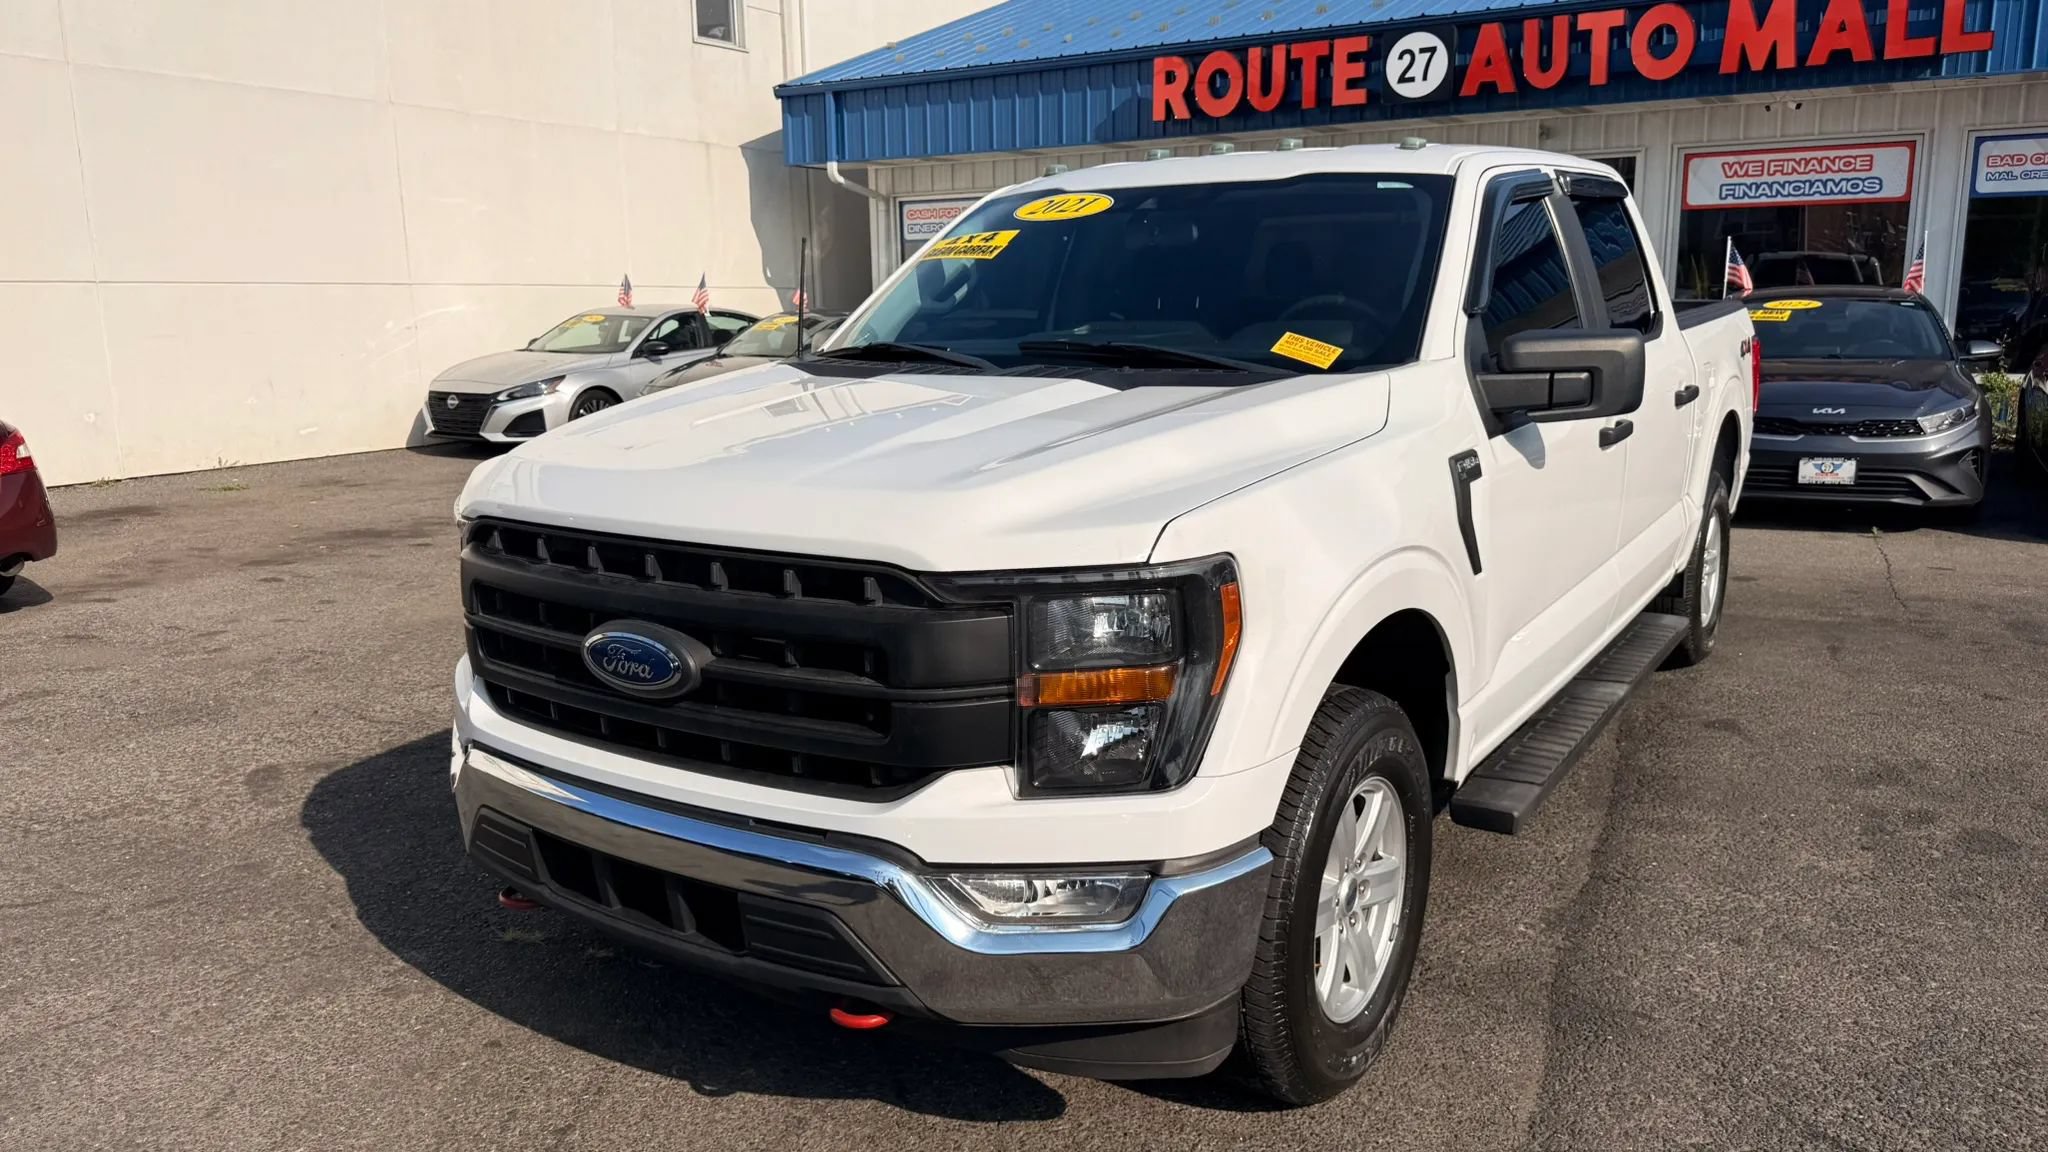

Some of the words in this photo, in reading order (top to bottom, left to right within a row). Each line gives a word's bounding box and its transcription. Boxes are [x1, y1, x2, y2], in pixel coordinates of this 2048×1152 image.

[1152, 36, 1368, 121] ROUTE
[1397, 46, 1437, 84] 27
[1459, 2, 1696, 97] AUTO
[1719, 0, 1994, 74] MALL
[1722, 159, 1764, 179] WE
[1768, 155, 1873, 177] FINANCE
[1987, 154, 2028, 168] BAD
[1986, 171, 2018, 182] MAL
[1719, 176, 1882, 200] FINANCIAMOS
[907, 208, 938, 220] CASH
[939, 207, 960, 218] FOR
[1026, 197, 1100, 215] 2021
[979, 232, 999, 242] 4
[954, 245, 1003, 257] CARFAX
[1285, 340, 1299, 348] NOT
[1314, 349, 1332, 357] SALE
[1287, 334, 1305, 343] THIS
[1305, 340, 1339, 353] VEHICLE
[1812, 407, 1846, 415] KIA
[602, 643, 655, 680] Ford
